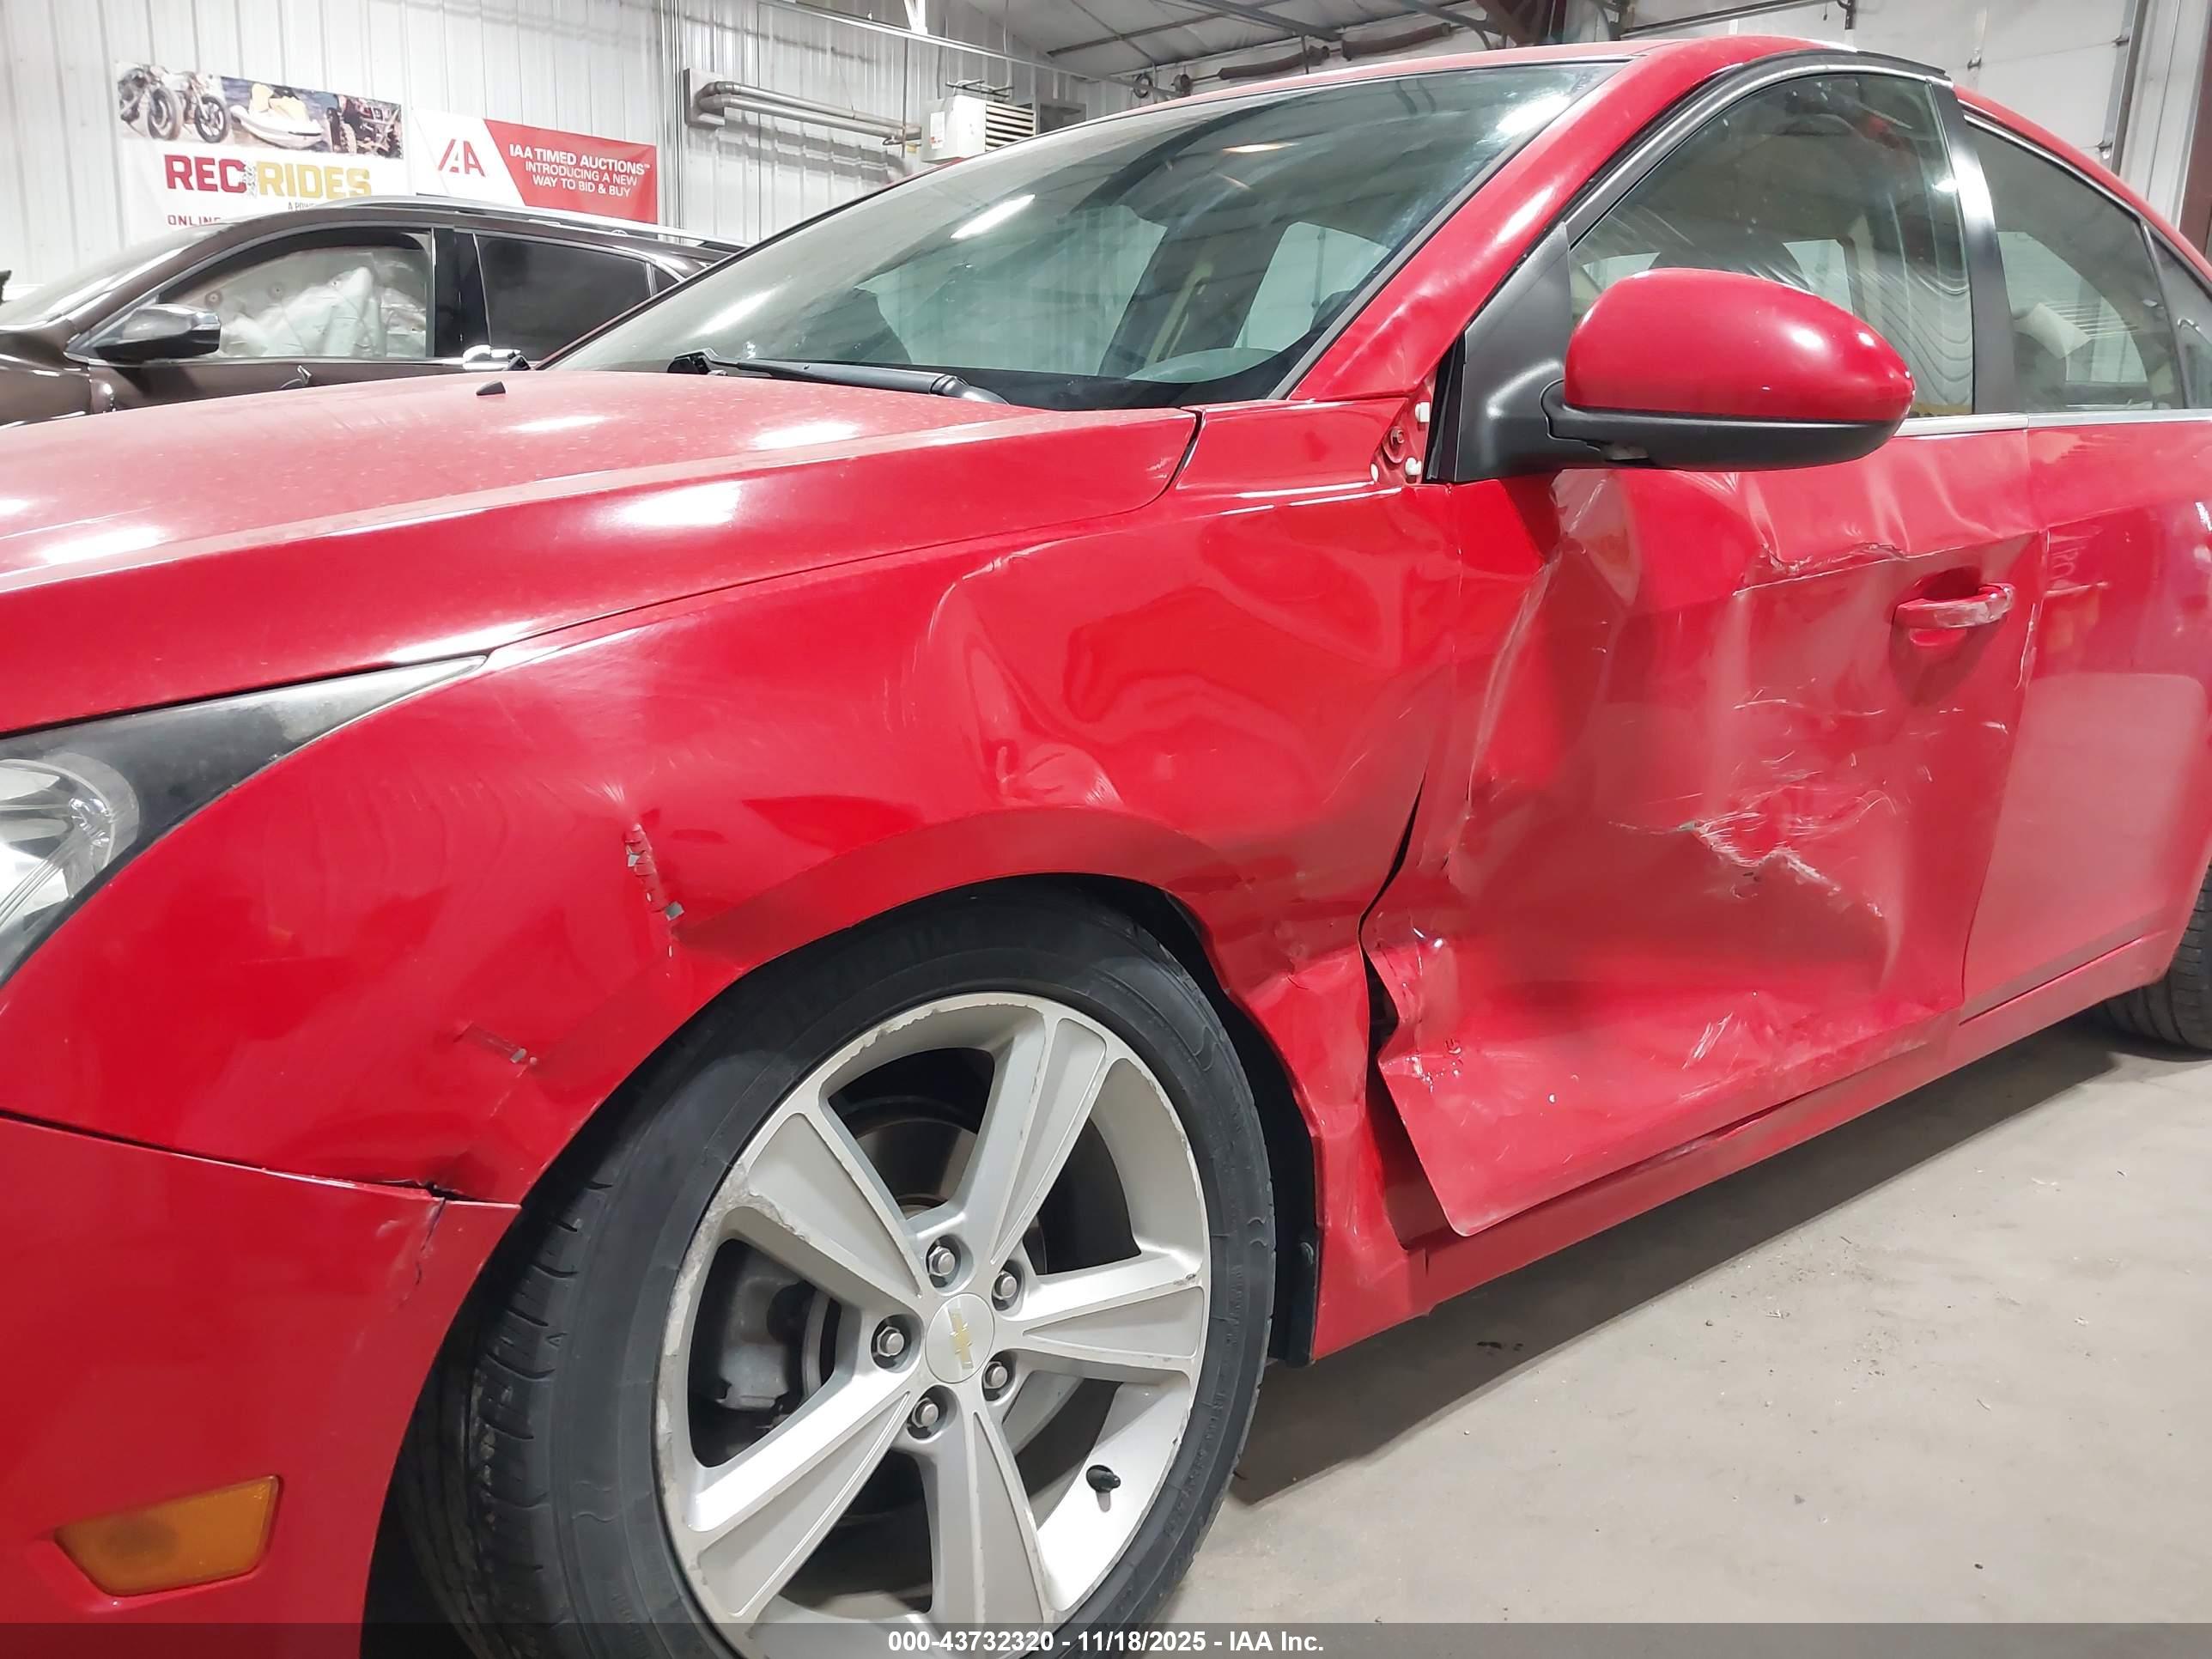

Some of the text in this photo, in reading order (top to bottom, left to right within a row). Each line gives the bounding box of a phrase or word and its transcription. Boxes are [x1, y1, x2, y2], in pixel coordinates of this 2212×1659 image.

[509, 143, 532, 159] IAA
[534, 148, 576, 166] TIMED
[164, 155, 371, 200] REC RIDES
[526, 161, 638, 186] INTRODUCING A NEW
[532, 174, 631, 198] WAY TO BID & BUY
